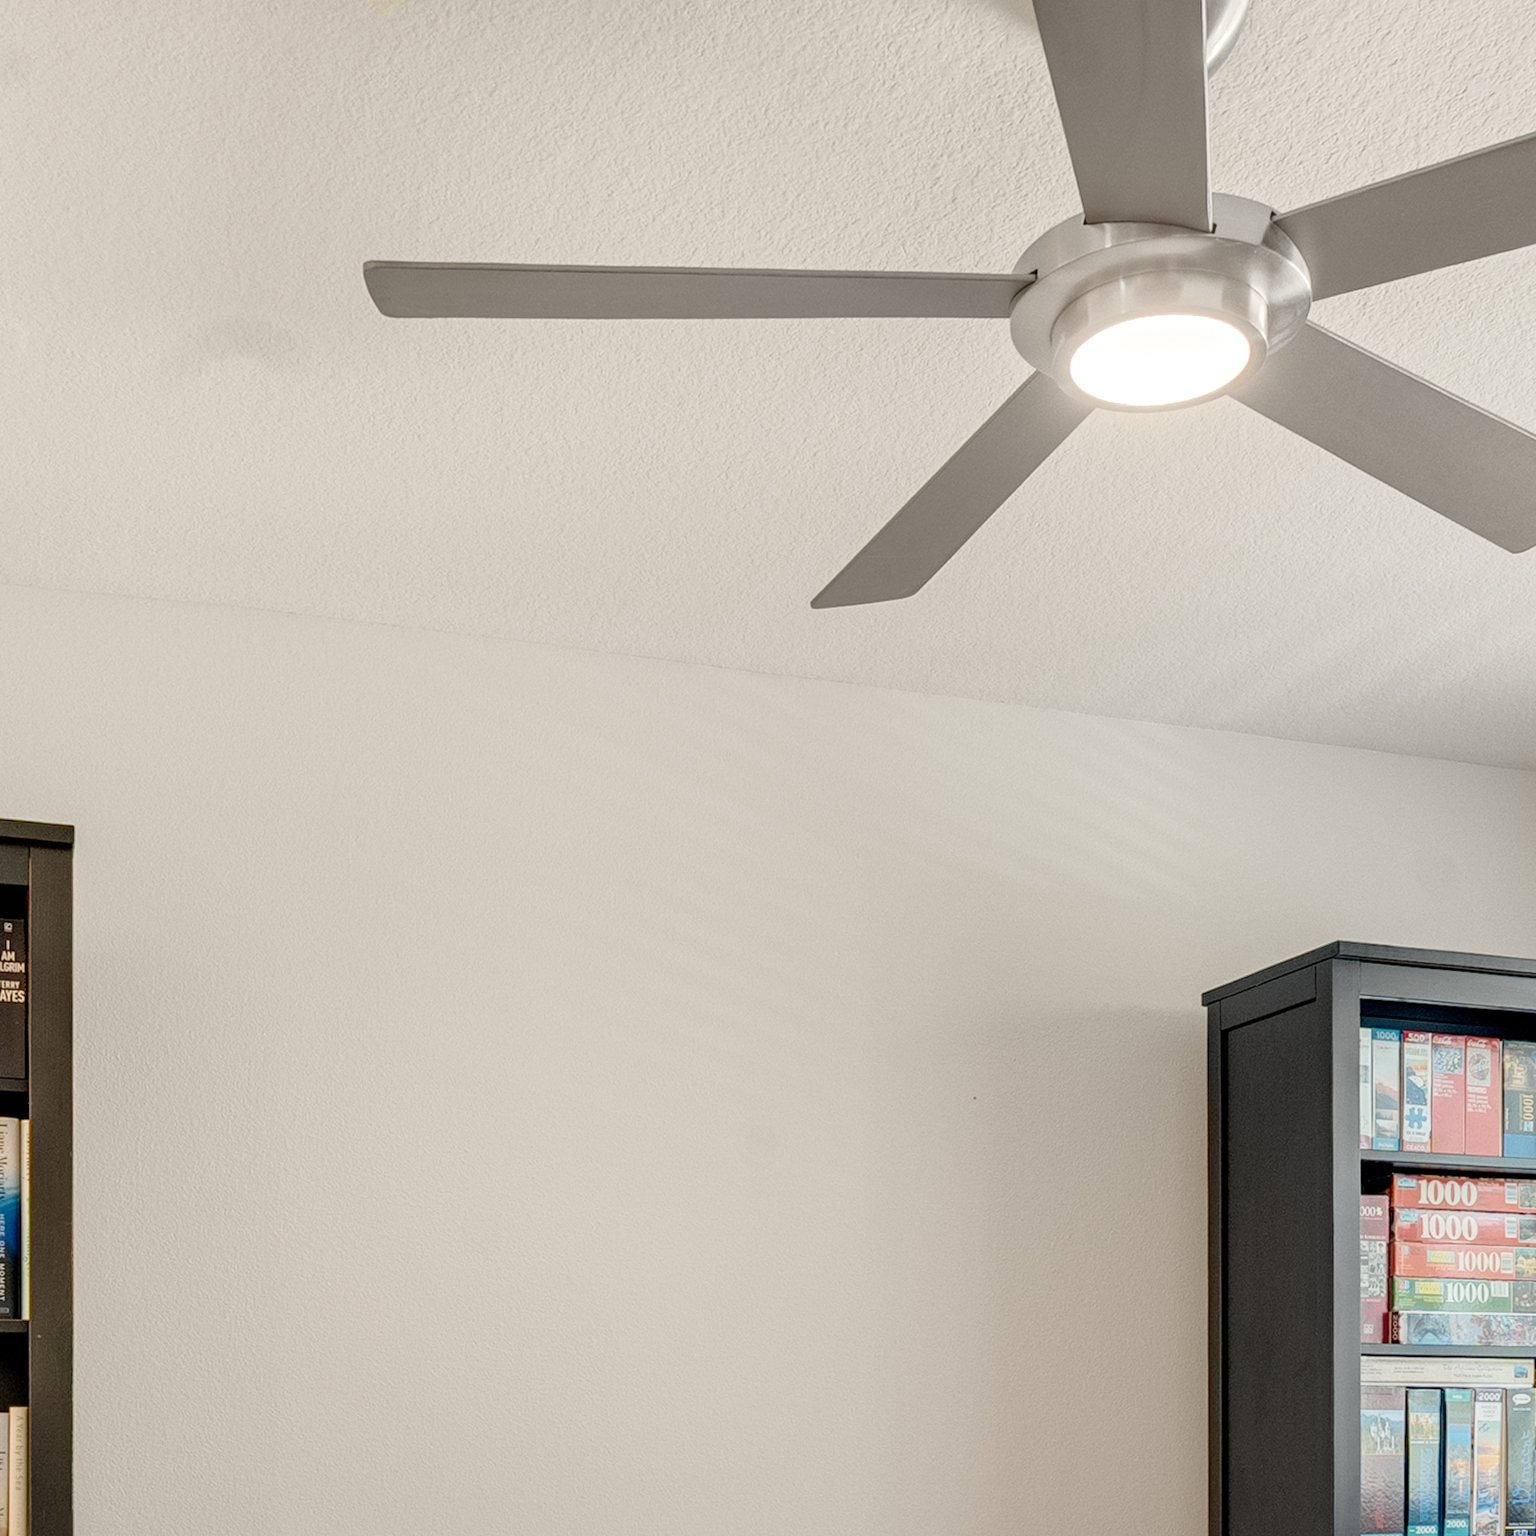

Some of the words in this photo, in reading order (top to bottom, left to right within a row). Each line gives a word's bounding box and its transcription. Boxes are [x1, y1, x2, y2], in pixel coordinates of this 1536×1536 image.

[6, 940, 10, 950] I
[1, 952, 15, 960] AM
[1418, 1179, 1478, 1206] 1000
[1420, 1214, 1478, 1241] 1000
[1457, 1251, 1501, 1272] 1000
[1446, 1282, 1489, 1303] 1000
[1478, 1392, 1500, 1401] 2000
